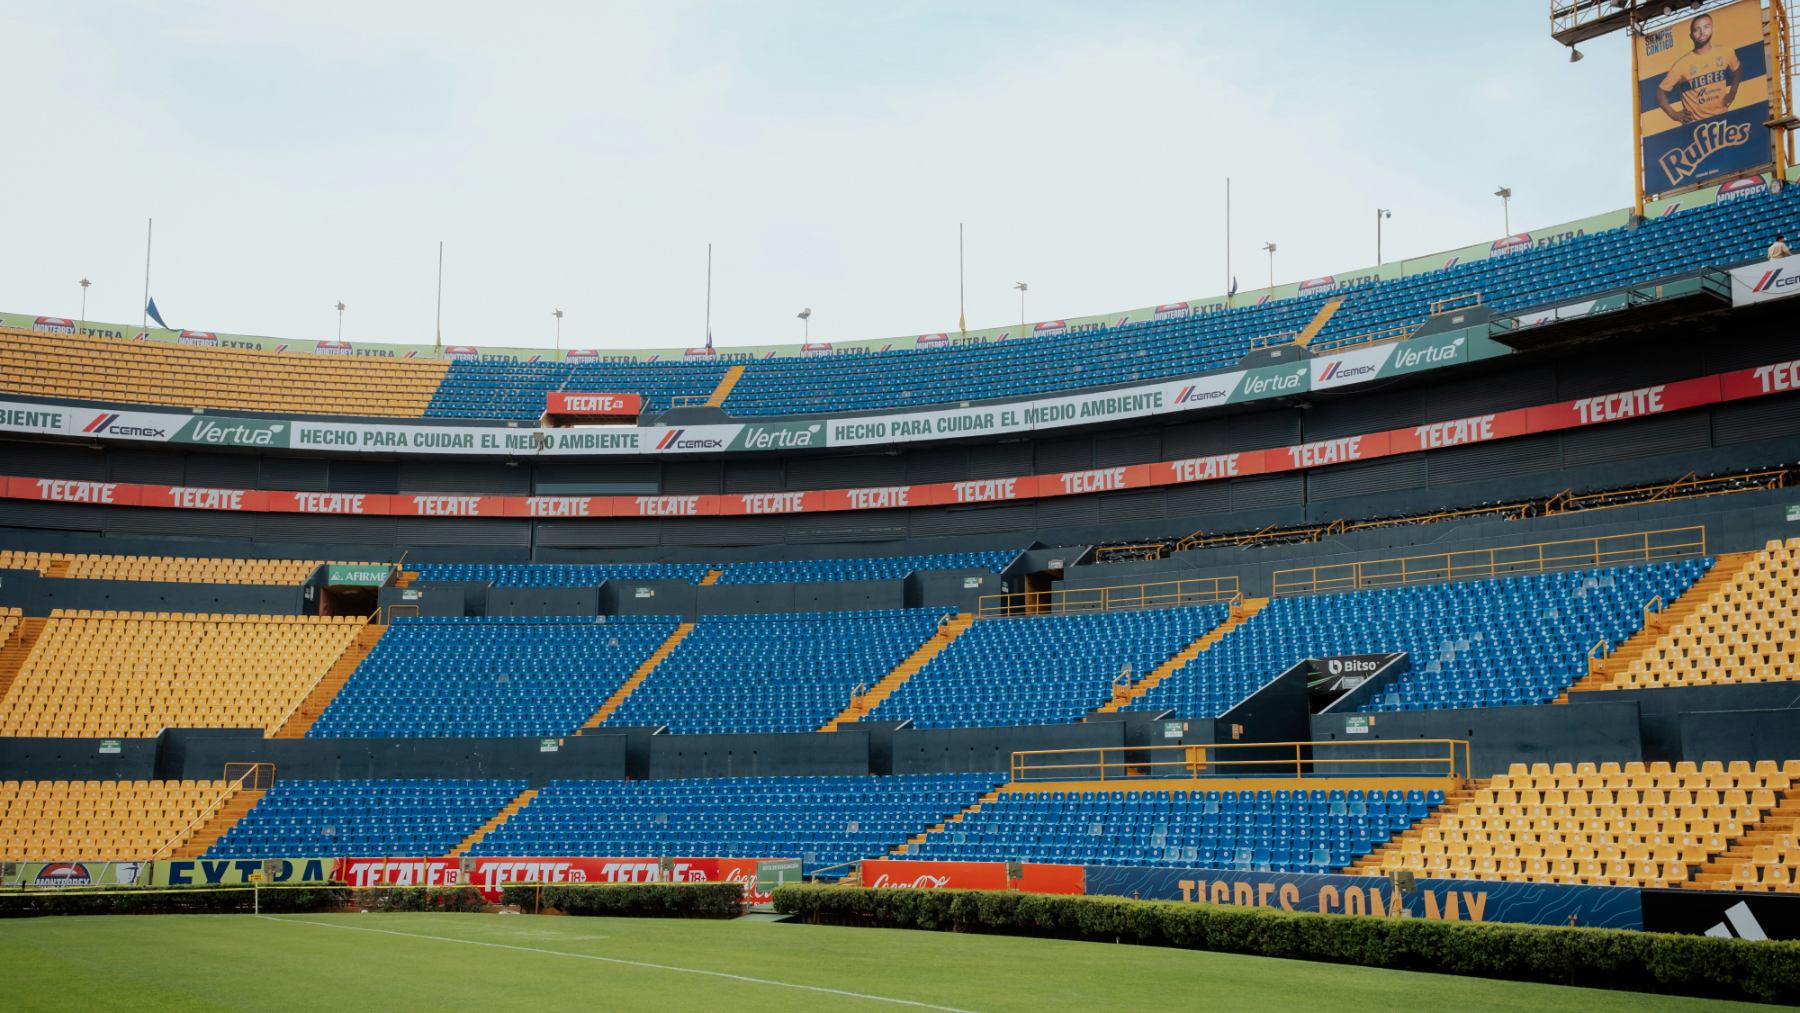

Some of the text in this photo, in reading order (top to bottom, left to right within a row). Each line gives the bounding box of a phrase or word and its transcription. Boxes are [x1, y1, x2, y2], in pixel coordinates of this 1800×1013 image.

[1690, 70, 1725, 88] TIGRES
[1659, 120, 1752, 186] Ruffles
[1337, 340, 1459, 379] CEMEX Vertua
[1190, 371, 1303, 402] CEMEX Vertua
[564, 396, 614, 411] TECATE
[835, 391, 1163, 441] HECHO PARA CUIDAR EL MEDIO AMBIENTE
[1573, 385, 1665, 424] TECATE
[110, 420, 275, 445] CEMEX Vertua
[300, 429, 639, 450] HECHO PARA CUIDAR EL MEDO AMBIENTE
[678, 428, 815, 449] CEMEX Vertua
[1414, 414, 1496, 449] TECATE
[1289, 435, 1363, 468] TECATE
[1171, 453, 1241, 482] TECATE
[36, 479, 117, 504] TECATE
[952, 478, 1017, 502] TECATE
[1061, 467, 1127, 494] TECATE
[169, 486, 245, 511] TECATE
[294, 492, 367, 514] TECATE
[413, 496, 481, 516] TECATE
[526, 496, 592, 517] TECATE
[635, 496, 700, 516] TECATE
[741, 492, 806, 513] TECATE
[847, 486, 911, 509] TECATE
[1344, 659, 1377, 672] Bitso
[349, 862, 445, 887] TECATE
[478, 862, 569, 892] TECATE
